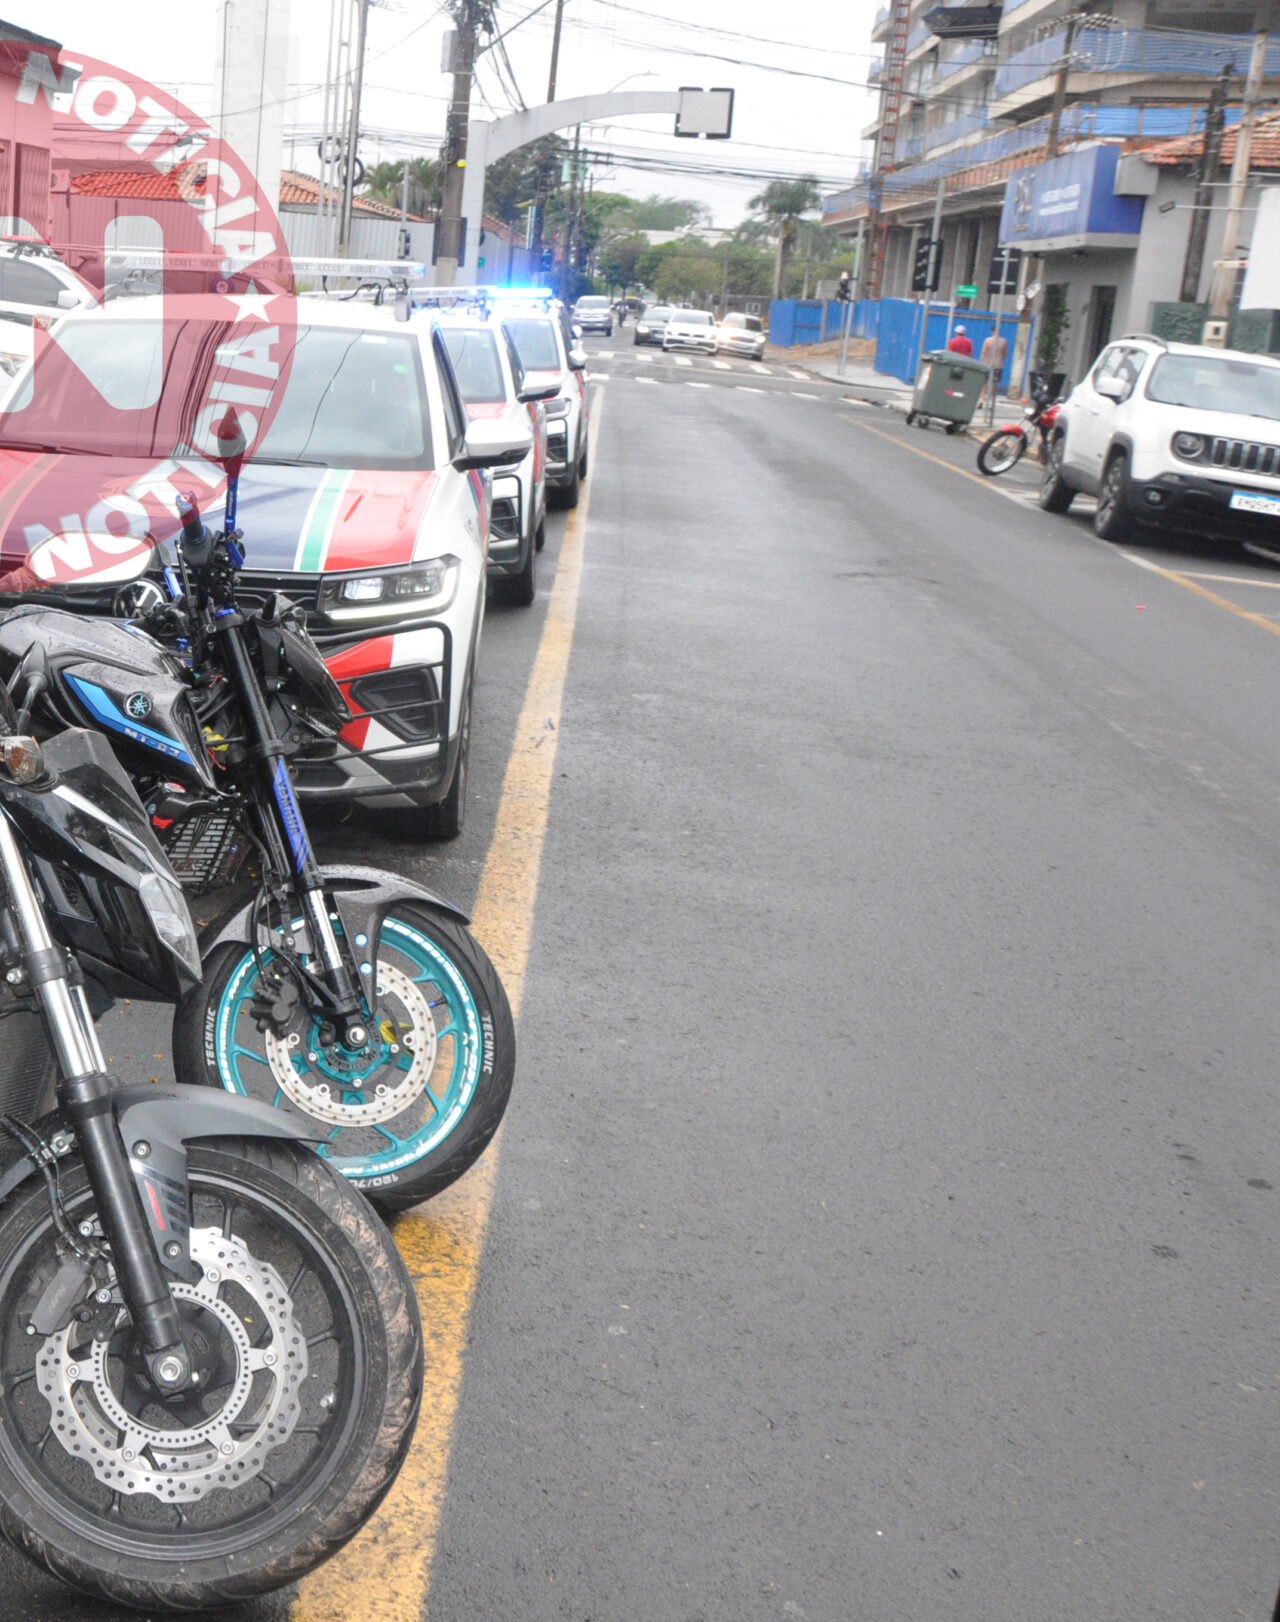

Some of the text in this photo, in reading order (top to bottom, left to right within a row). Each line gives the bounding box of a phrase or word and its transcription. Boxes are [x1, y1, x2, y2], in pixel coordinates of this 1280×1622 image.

[124, 727, 181, 758] MT-03
[276, 780, 301, 836] YAMAHA
[205, 1007, 217, 1067] TECHNIC
[481, 1015, 495, 1074] TECHNIC
